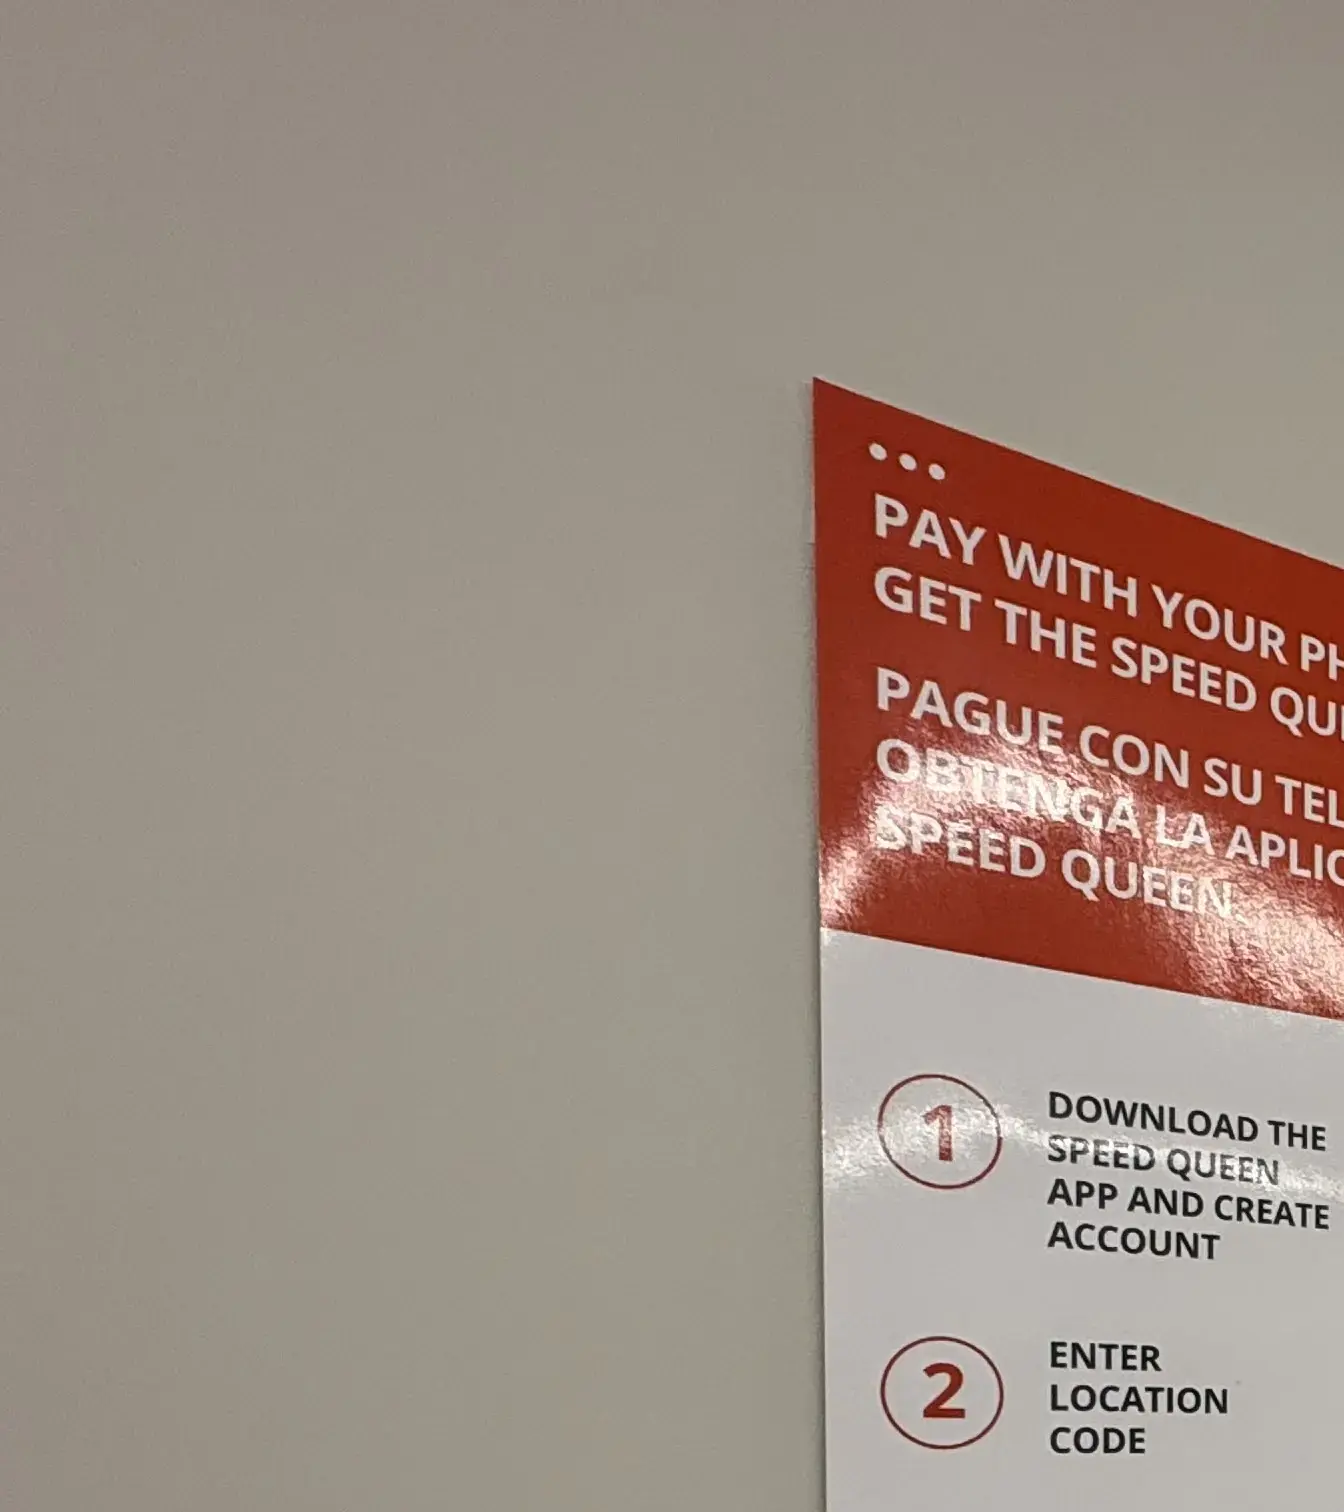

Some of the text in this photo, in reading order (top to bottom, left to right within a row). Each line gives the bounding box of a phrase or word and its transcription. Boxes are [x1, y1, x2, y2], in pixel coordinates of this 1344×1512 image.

[874, 493, 987, 565] PAY
[997, 534, 1138, 616] WITH
[1151, 584, 1289, 665] YOUR
[874, 567, 981, 631] GET
[994, 598, 1097, 668] THE
[1111, 637, 1256, 712] SPEED
[876, 667, 1065, 756] PAGUE
[1079, 724, 1190, 787] CON
[1204, 757, 1263, 805] SU
[875, 737, 1141, 840] OBTENGA
[1155, 801, 1214, 855] LA
[874, 807, 1046, 879] SPEED
[923, 1104, 953, 1162] 1
[1048, 1091, 1327, 1151] DOWNLOAD THE
[1047, 1135, 1279, 1186] SPEED QUEEN
[1047, 1178, 1330, 1229] APP AND CREATE
[1047, 1221, 1220, 1260] ACCOUNT
[1050, 1341, 1162, 1372] ENTER
[922, 1362, 965, 1419] 2
[1050, 1384, 1228, 1414] LOCATION
[1050, 1427, 1146, 1454] CODE
